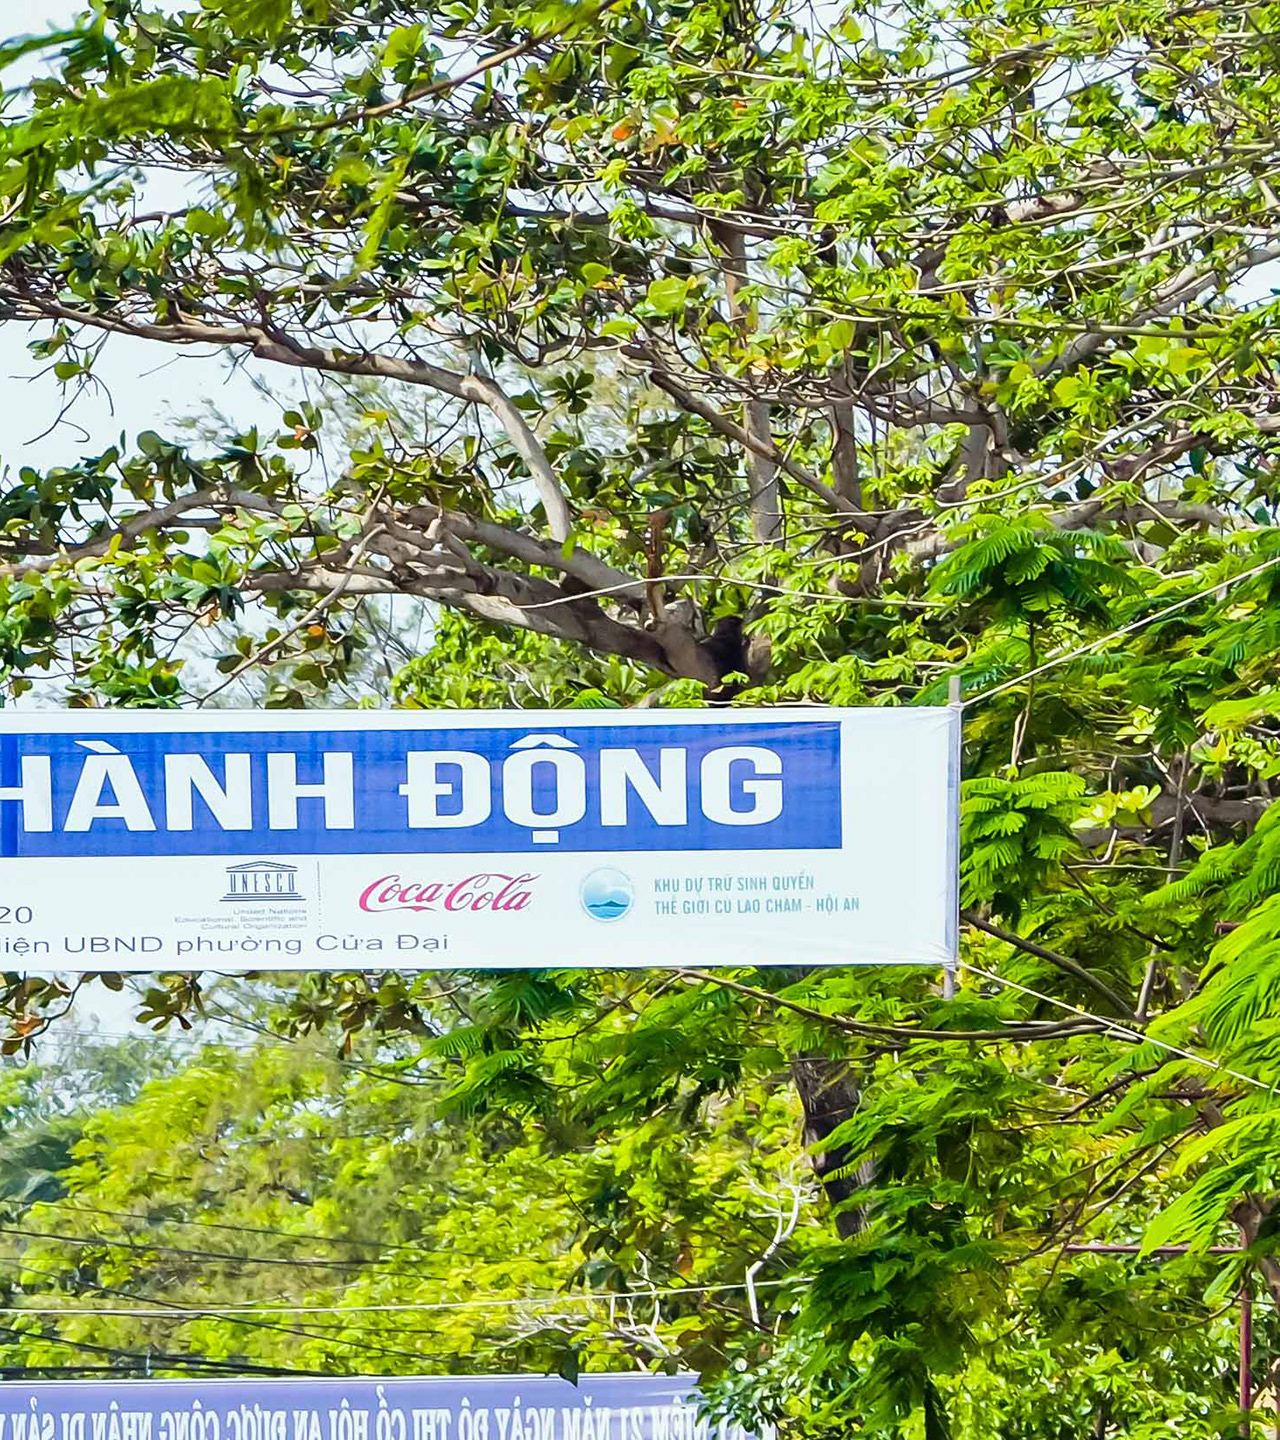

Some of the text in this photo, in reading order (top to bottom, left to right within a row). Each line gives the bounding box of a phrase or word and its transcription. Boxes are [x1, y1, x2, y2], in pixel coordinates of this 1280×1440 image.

[399, 732, 785, 844] ĐỘNG
[229, 872, 295, 893] UNESCO
[359, 871, 542, 914] Coca-Cola
[654, 878, 680, 892] KHU
[737, 876, 767, 891] SINH
[737, 898, 761, 913] LAO
[843, 897, 860, 911] AN
[63, 935, 164, 955] UBND
[175, 932, 302, 958] phường
[315, 930, 384, 952] Cửa
[395, 933, 449, 952] Đại
